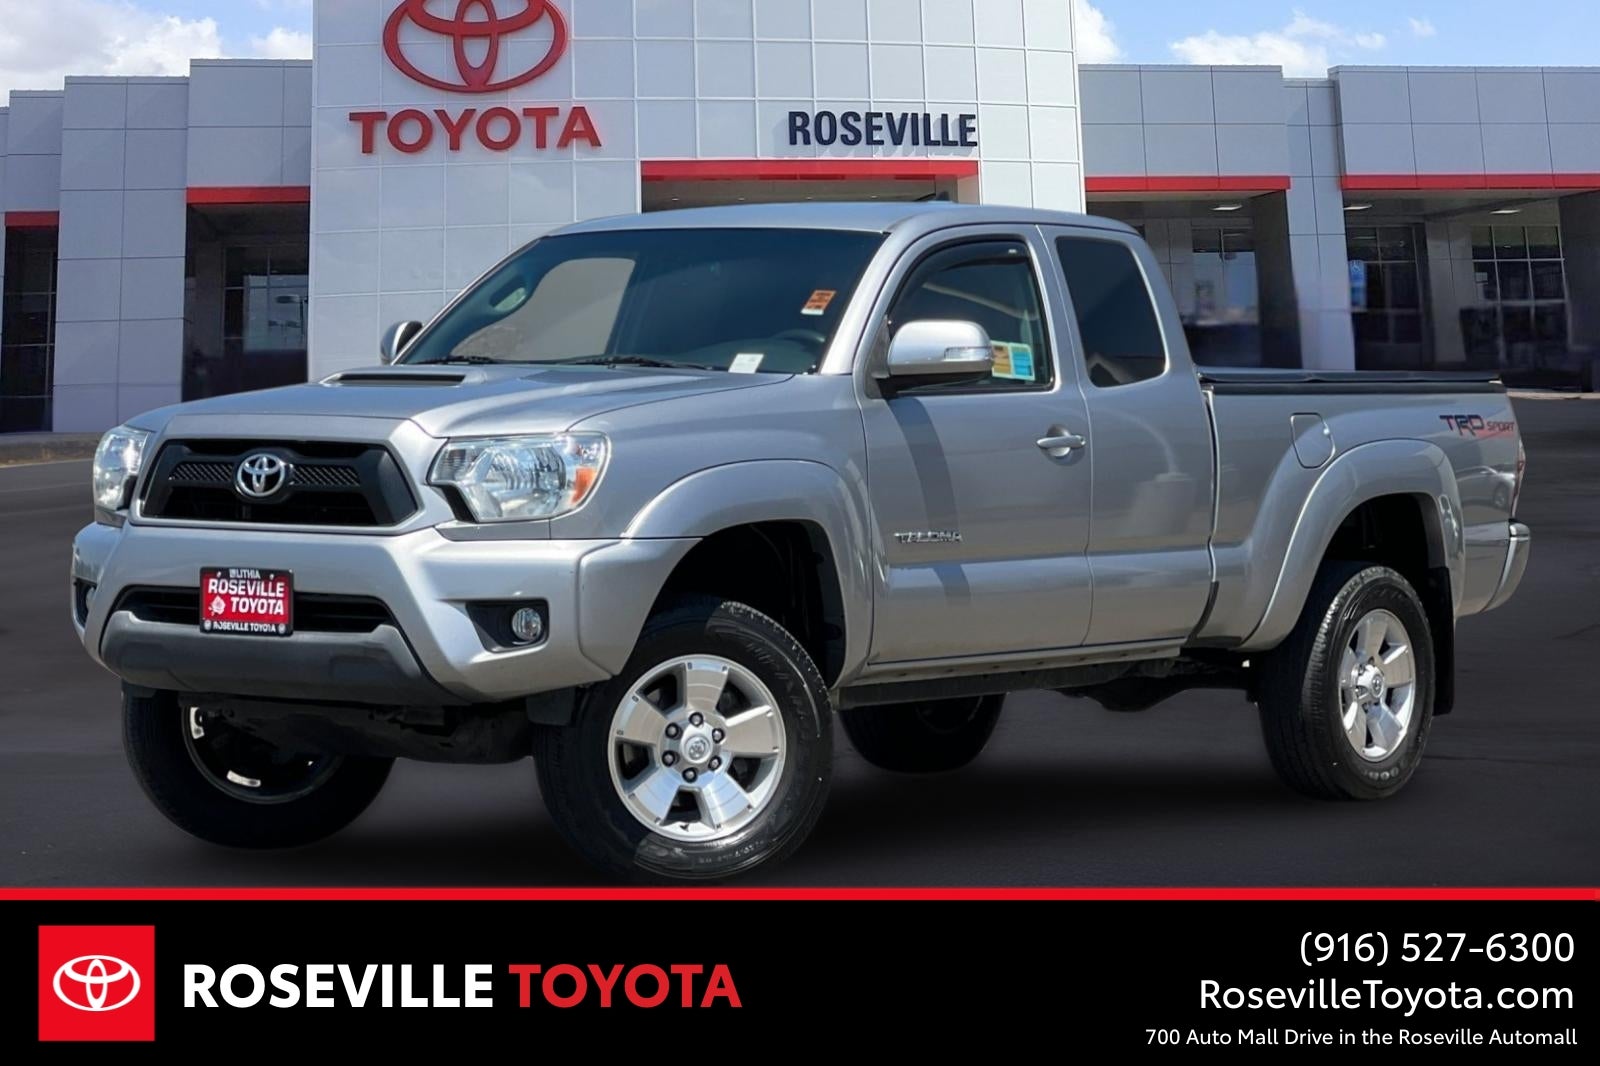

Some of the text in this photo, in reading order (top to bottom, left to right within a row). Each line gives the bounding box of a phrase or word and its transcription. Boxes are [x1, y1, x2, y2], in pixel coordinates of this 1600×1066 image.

[349, 106, 602, 154] TOYOTA
[788, 111, 978, 147] ROSEVILLE
[1439, 414, 1515, 436] TRD SPORT
[236, 569, 261, 579] LITHIA
[208, 579, 285, 597] ROSEVILLE
[230, 597, 284, 615] TOYOTA
[213, 621, 276, 632] ROSEVILLE TOYOTA
